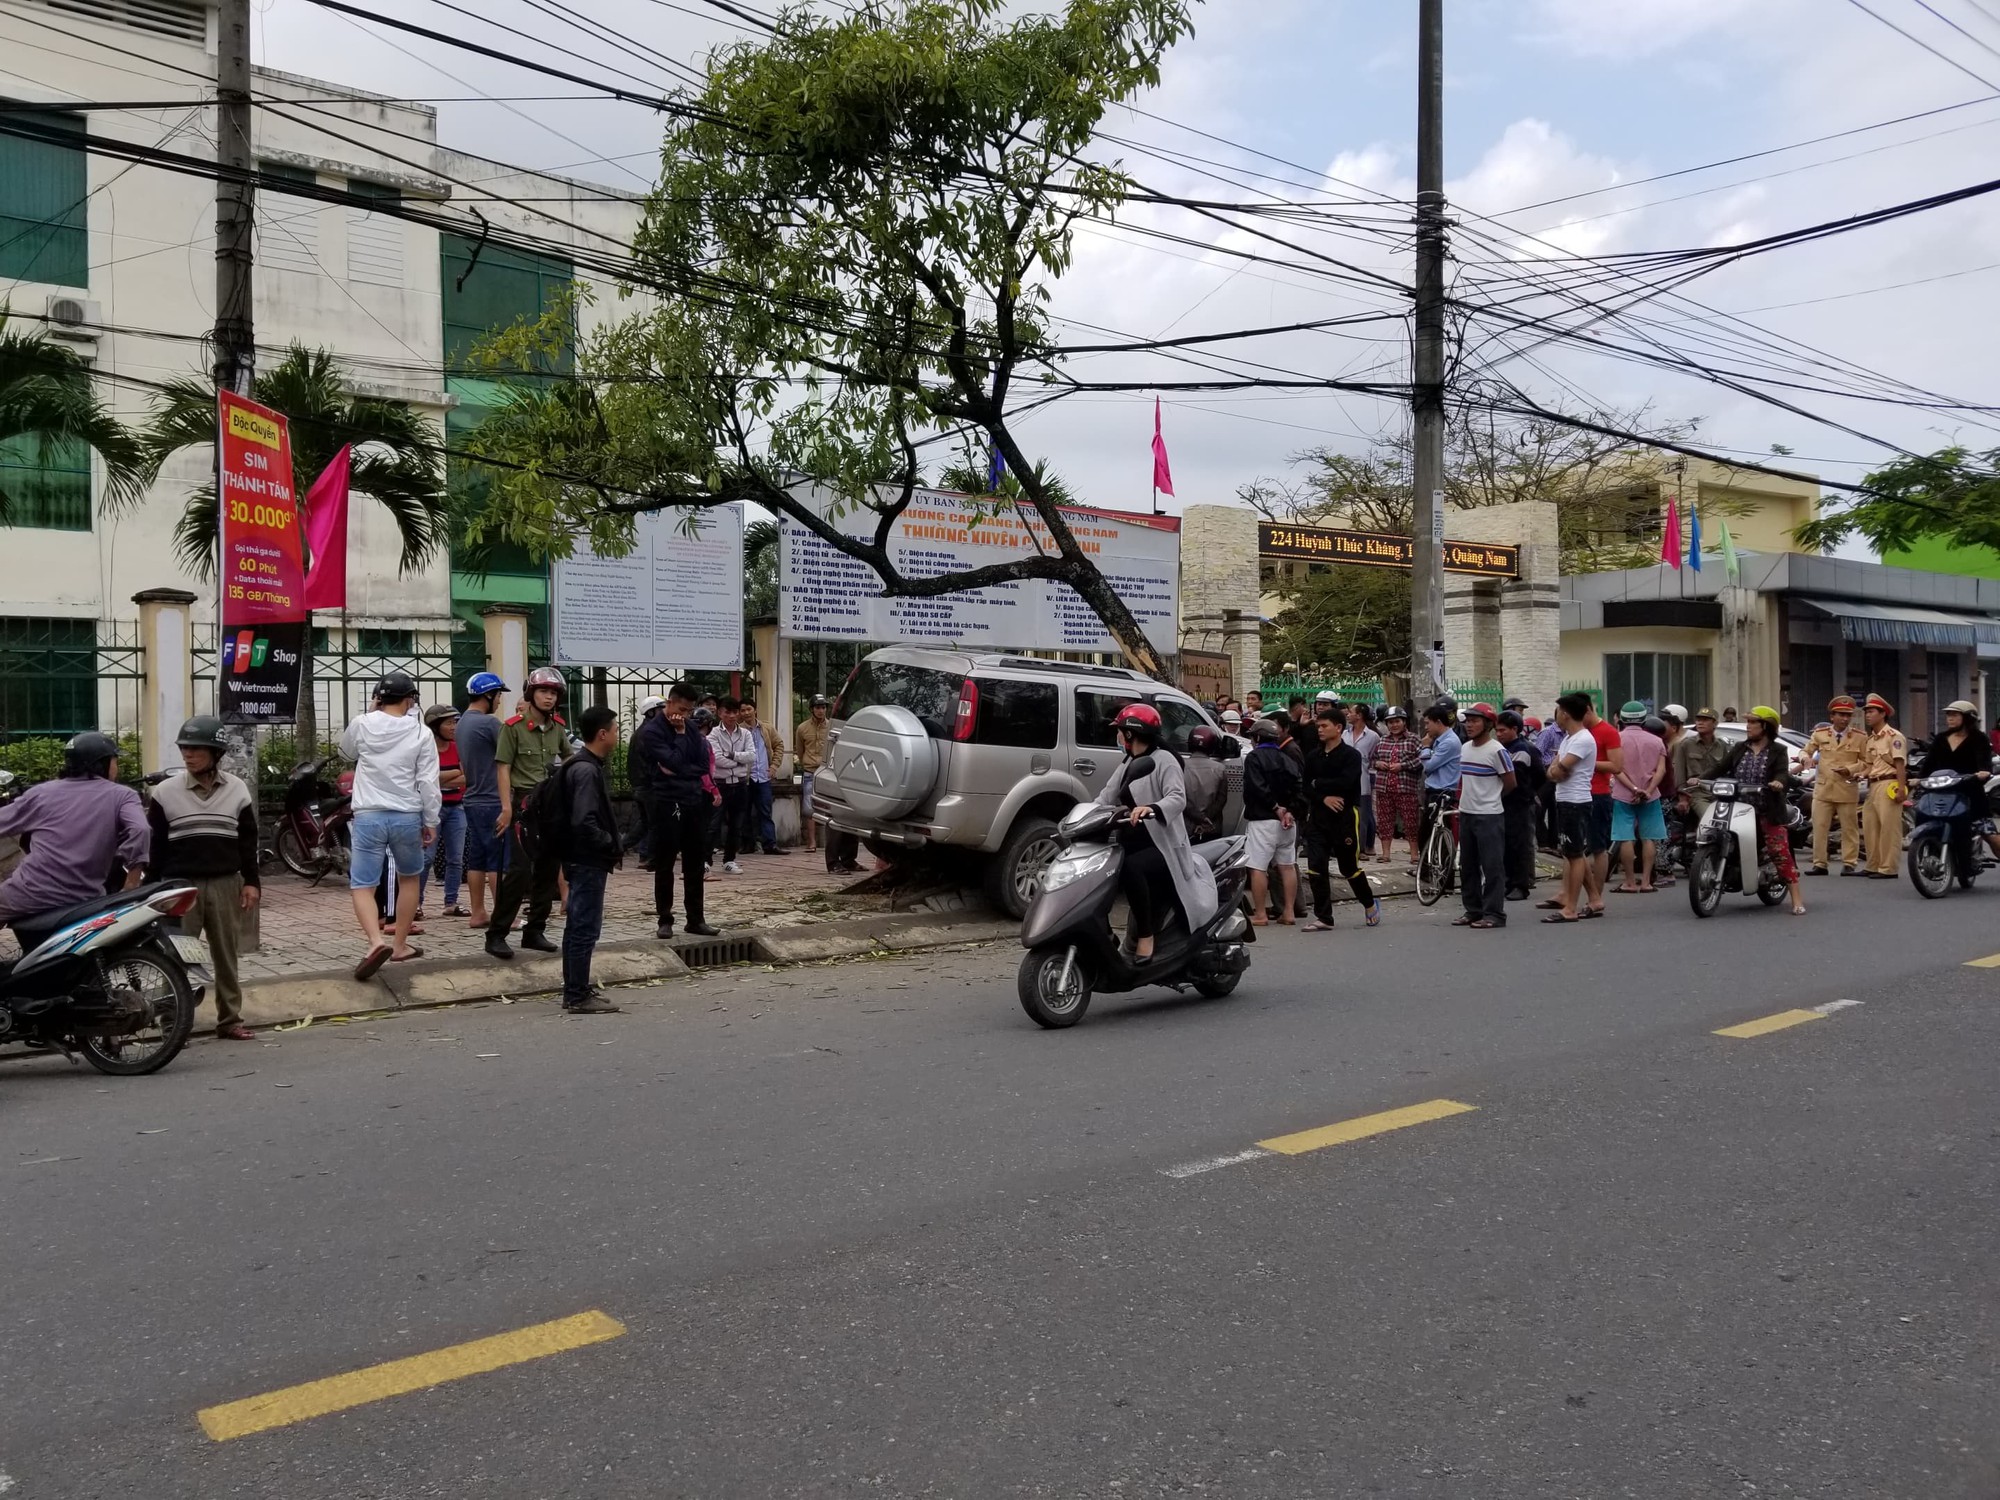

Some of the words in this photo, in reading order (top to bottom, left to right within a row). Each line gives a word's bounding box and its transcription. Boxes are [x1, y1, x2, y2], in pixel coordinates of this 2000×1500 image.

[233, 414, 249, 431] Độc
[250, 421, 276, 441] Quyền
[244, 451, 268, 471] SIM
[223, 470, 266, 494] THÁNH
[268, 481, 290, 501] TÁM
[915, 492, 933, 504] ỦY
[934, 497, 956, 507] BAN
[792, 528, 806, 537] ĐÀO
[902, 523, 967, 542] THƯỜNG
[972, 530, 1018, 547] XUYÊN
[1093, 529, 1118, 538] NAM
[235, 544, 246, 554] Gọi
[802, 540, 821, 548] Công
[1270, 531, 1293, 546] 224
[1295, 533, 1332, 553] Huỳnh
[1334, 536, 1363, 553] Thúc
[1366, 539, 1404, 561] Kháng,
[1452, 548, 1484, 568] Quảng
[1486, 550, 1507, 566] Nam
[803, 549, 820, 558] Điện
[239, 557, 256, 572] 60
[259, 562, 277, 575] Phút
[803, 558, 820, 567] Điện
[821, 561, 839, 569] công
[841, 562, 867, 571] nghiệp.
[950, 562, 974, 570] nghiệp.
[802, 568, 822, 576] Công
[823, 570, 841, 578] nghệ
[843, 571, 863, 579] thông
[909, 567, 924, 575] Điện
[822, 579, 841, 587] dụng
[229, 584, 244, 599] 135
[247, 591, 290, 607] GB/Tháng
[793, 585, 808, 593] ĐÀO
[810, 587, 823, 595] TẠO
[825, 588, 848, 596] TRUNG
[849, 589, 863, 597] CẤP
[803, 596, 822, 604] Công
[823, 598, 842, 606] nghệ
[908, 602, 921, 610] May
[940, 611, 952, 619] CẤP
[1063, 612, 1075, 620] Đào
[804, 624, 820, 633] Điện
[841, 627, 868, 635] nghiệp.
[910, 628, 923, 636] May
[1085, 629, 1100, 637] Quản
[273, 649, 297, 666] Shop
[242, 682, 288, 693] vietnamobile
[240, 702, 258, 714] 1800
[259, 702, 276, 714] 6601
